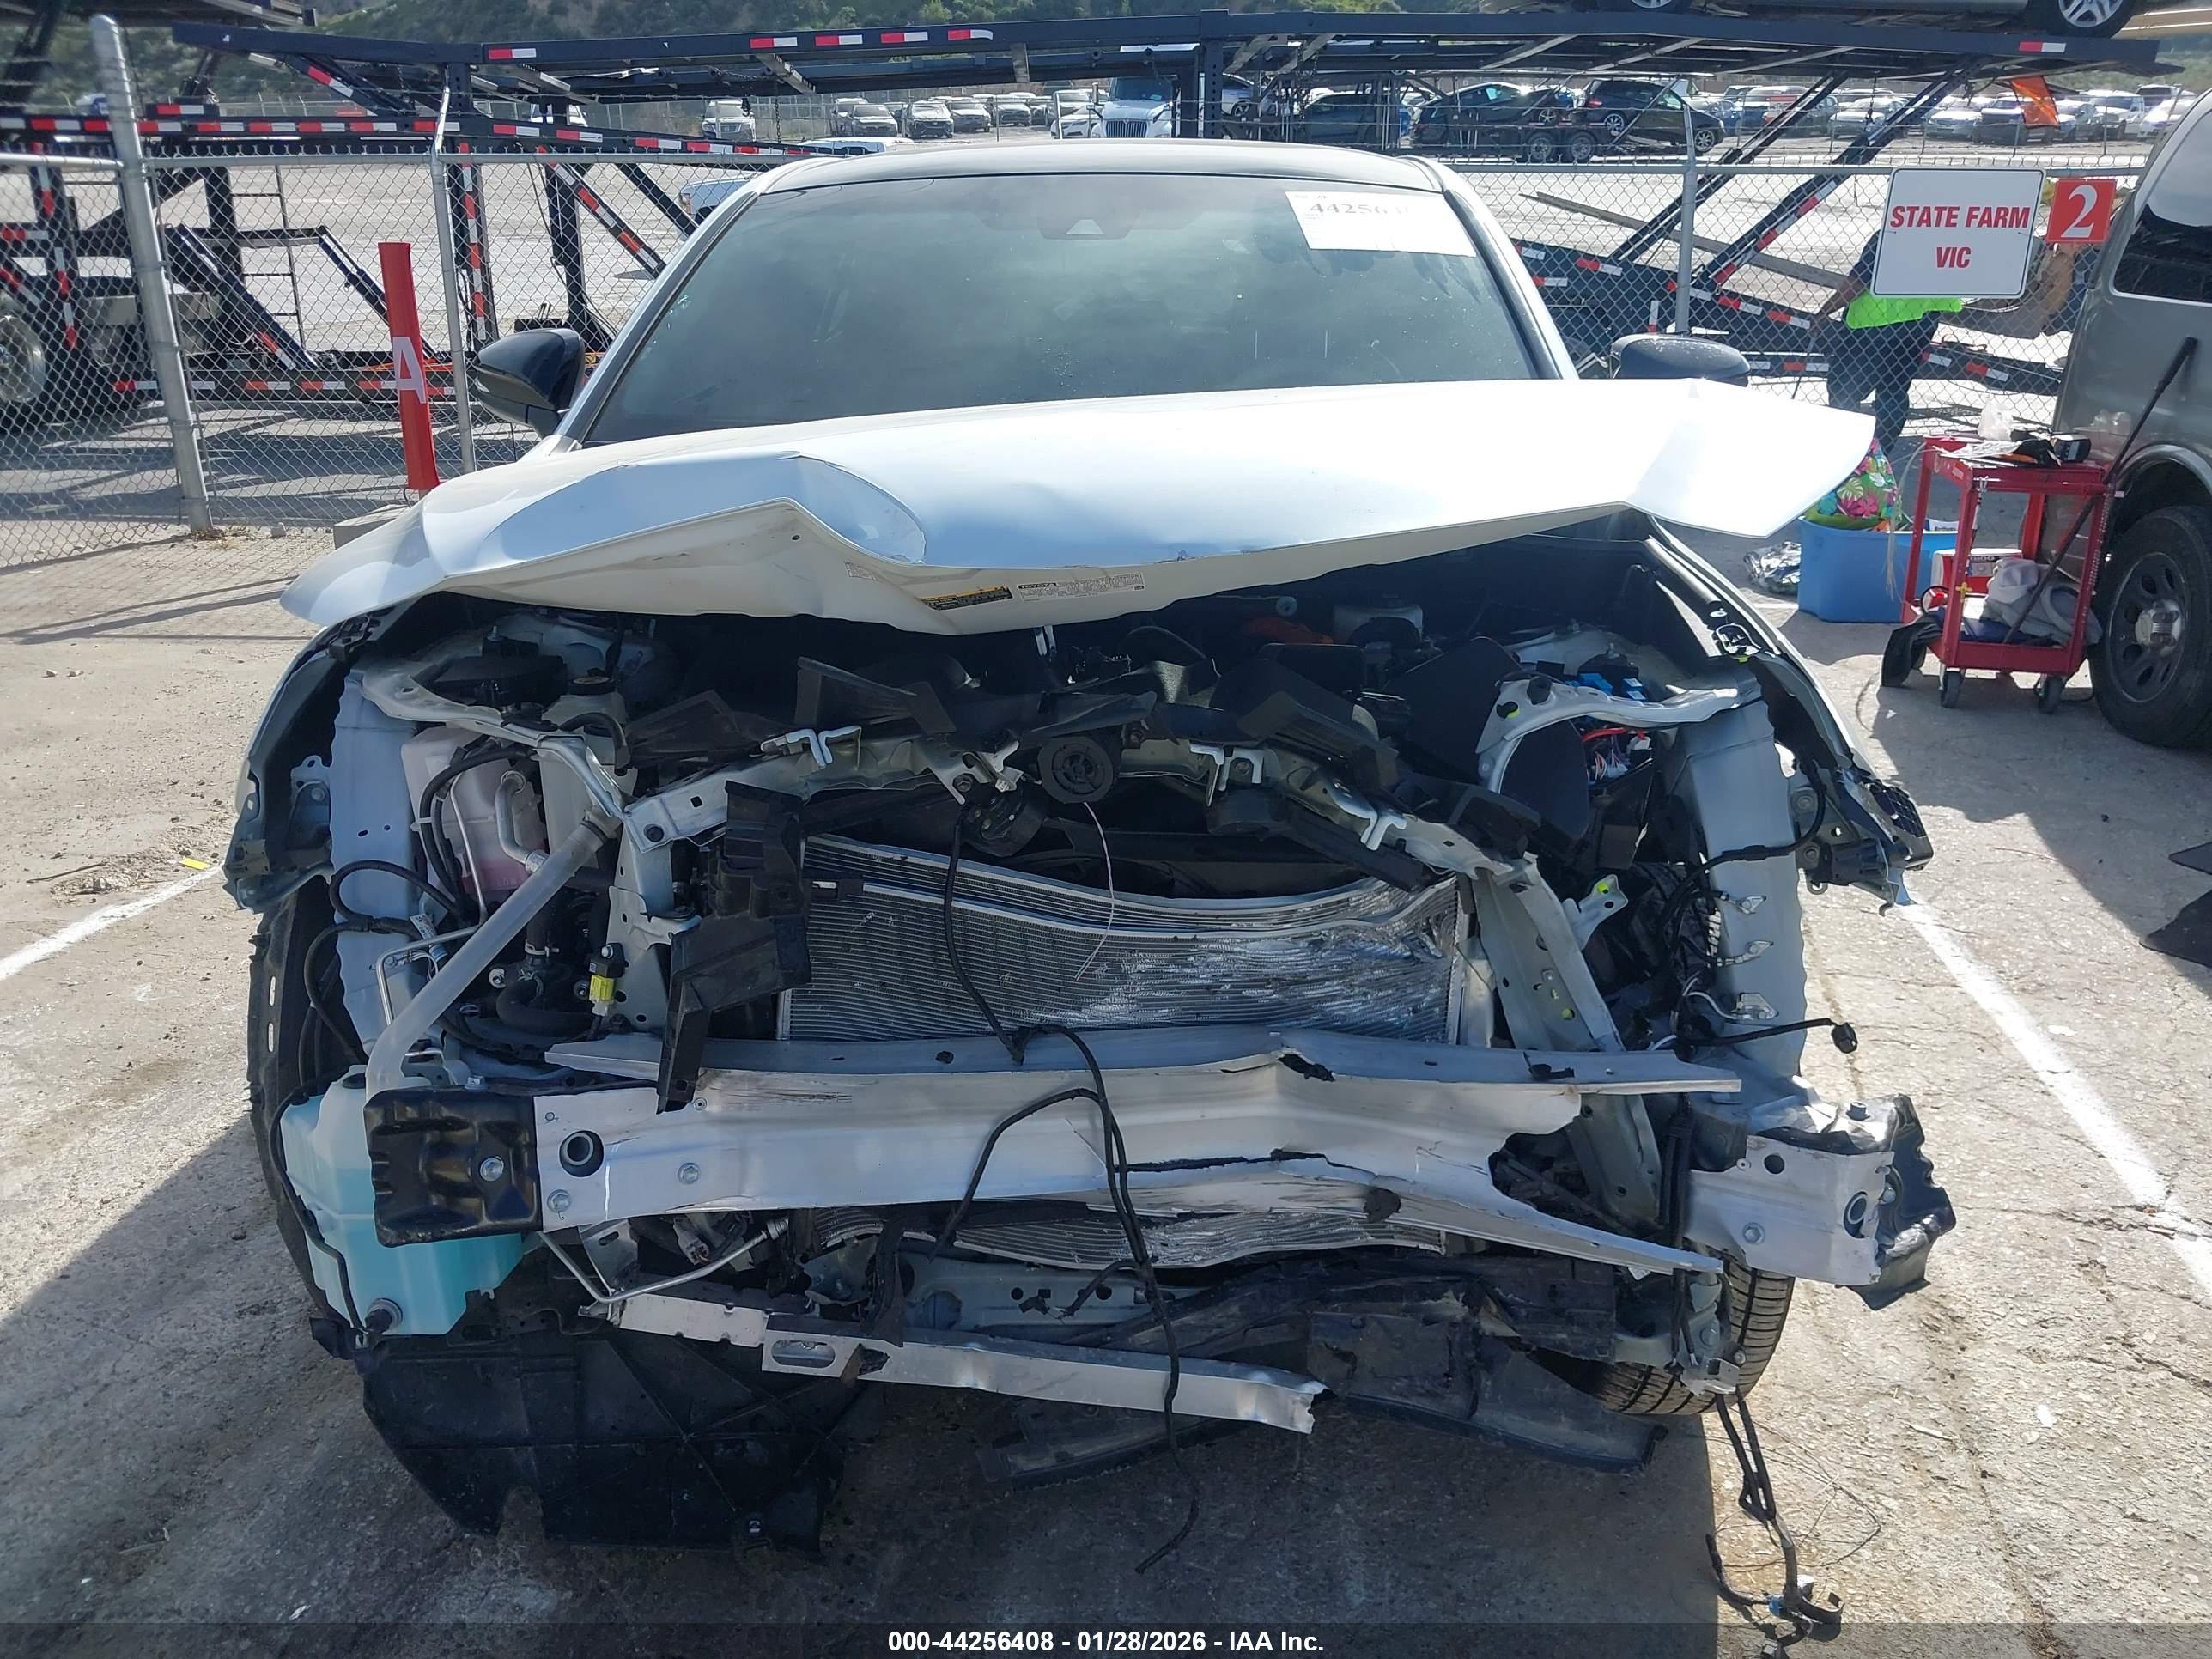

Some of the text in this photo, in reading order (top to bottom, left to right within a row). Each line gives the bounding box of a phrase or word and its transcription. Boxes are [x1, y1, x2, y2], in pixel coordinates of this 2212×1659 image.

[1890, 205, 2032, 228] STATE FARM
[2060, 184, 2098, 239] 2
[1936, 246, 1972, 269] VIC
[392, 336, 427, 404] A
